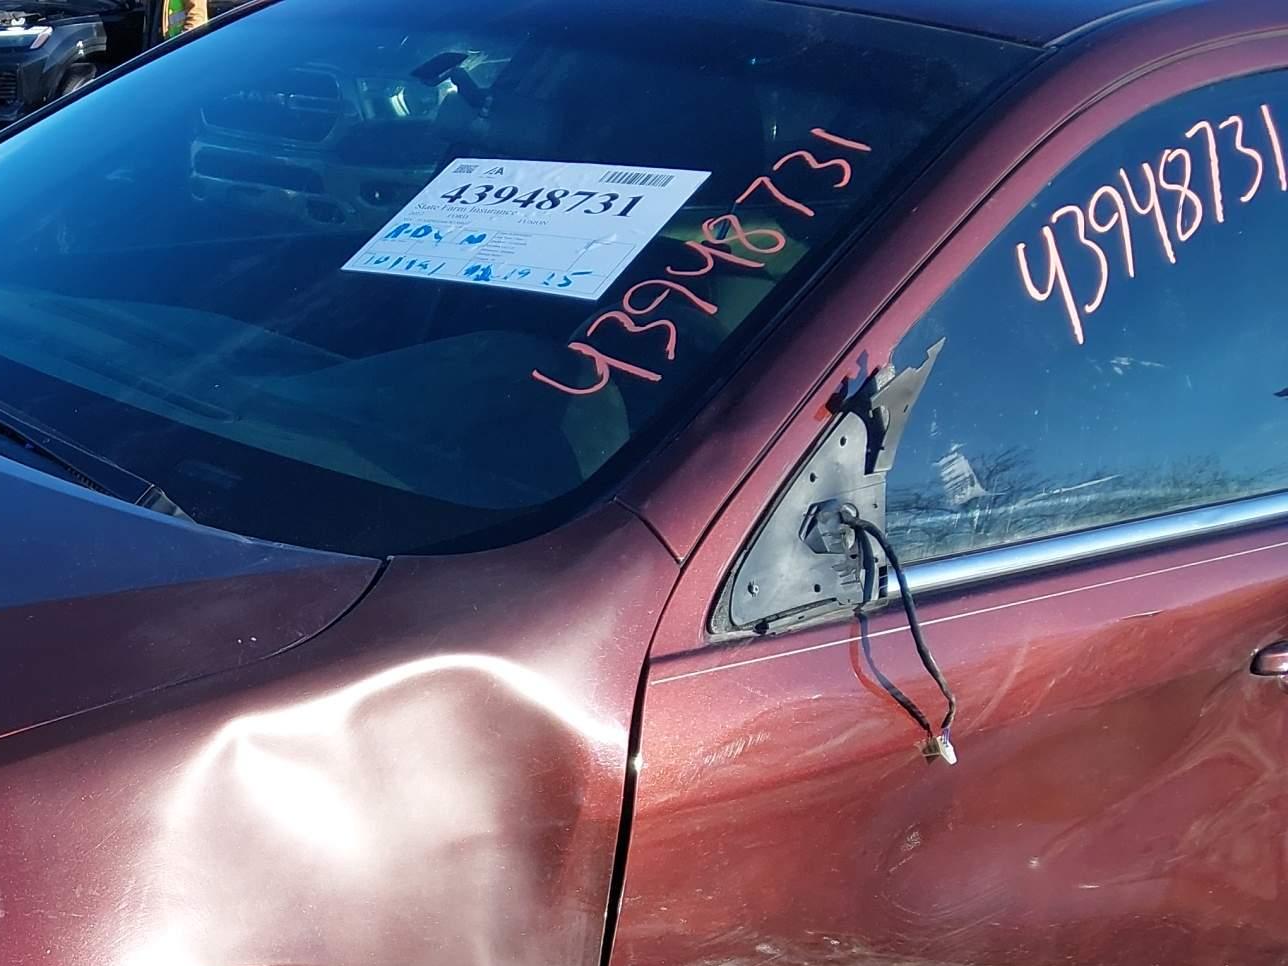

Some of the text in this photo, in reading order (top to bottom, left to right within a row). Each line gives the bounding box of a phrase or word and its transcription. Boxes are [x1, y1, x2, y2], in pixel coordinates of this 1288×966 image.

[440, 183, 644, 218] 43948731
[441, 203, 467, 213] Farm
[468, 204, 518, 216] Insurance
[532, 127, 872, 396] 43948731
[1016, 104, 1287, 345] 43948731
